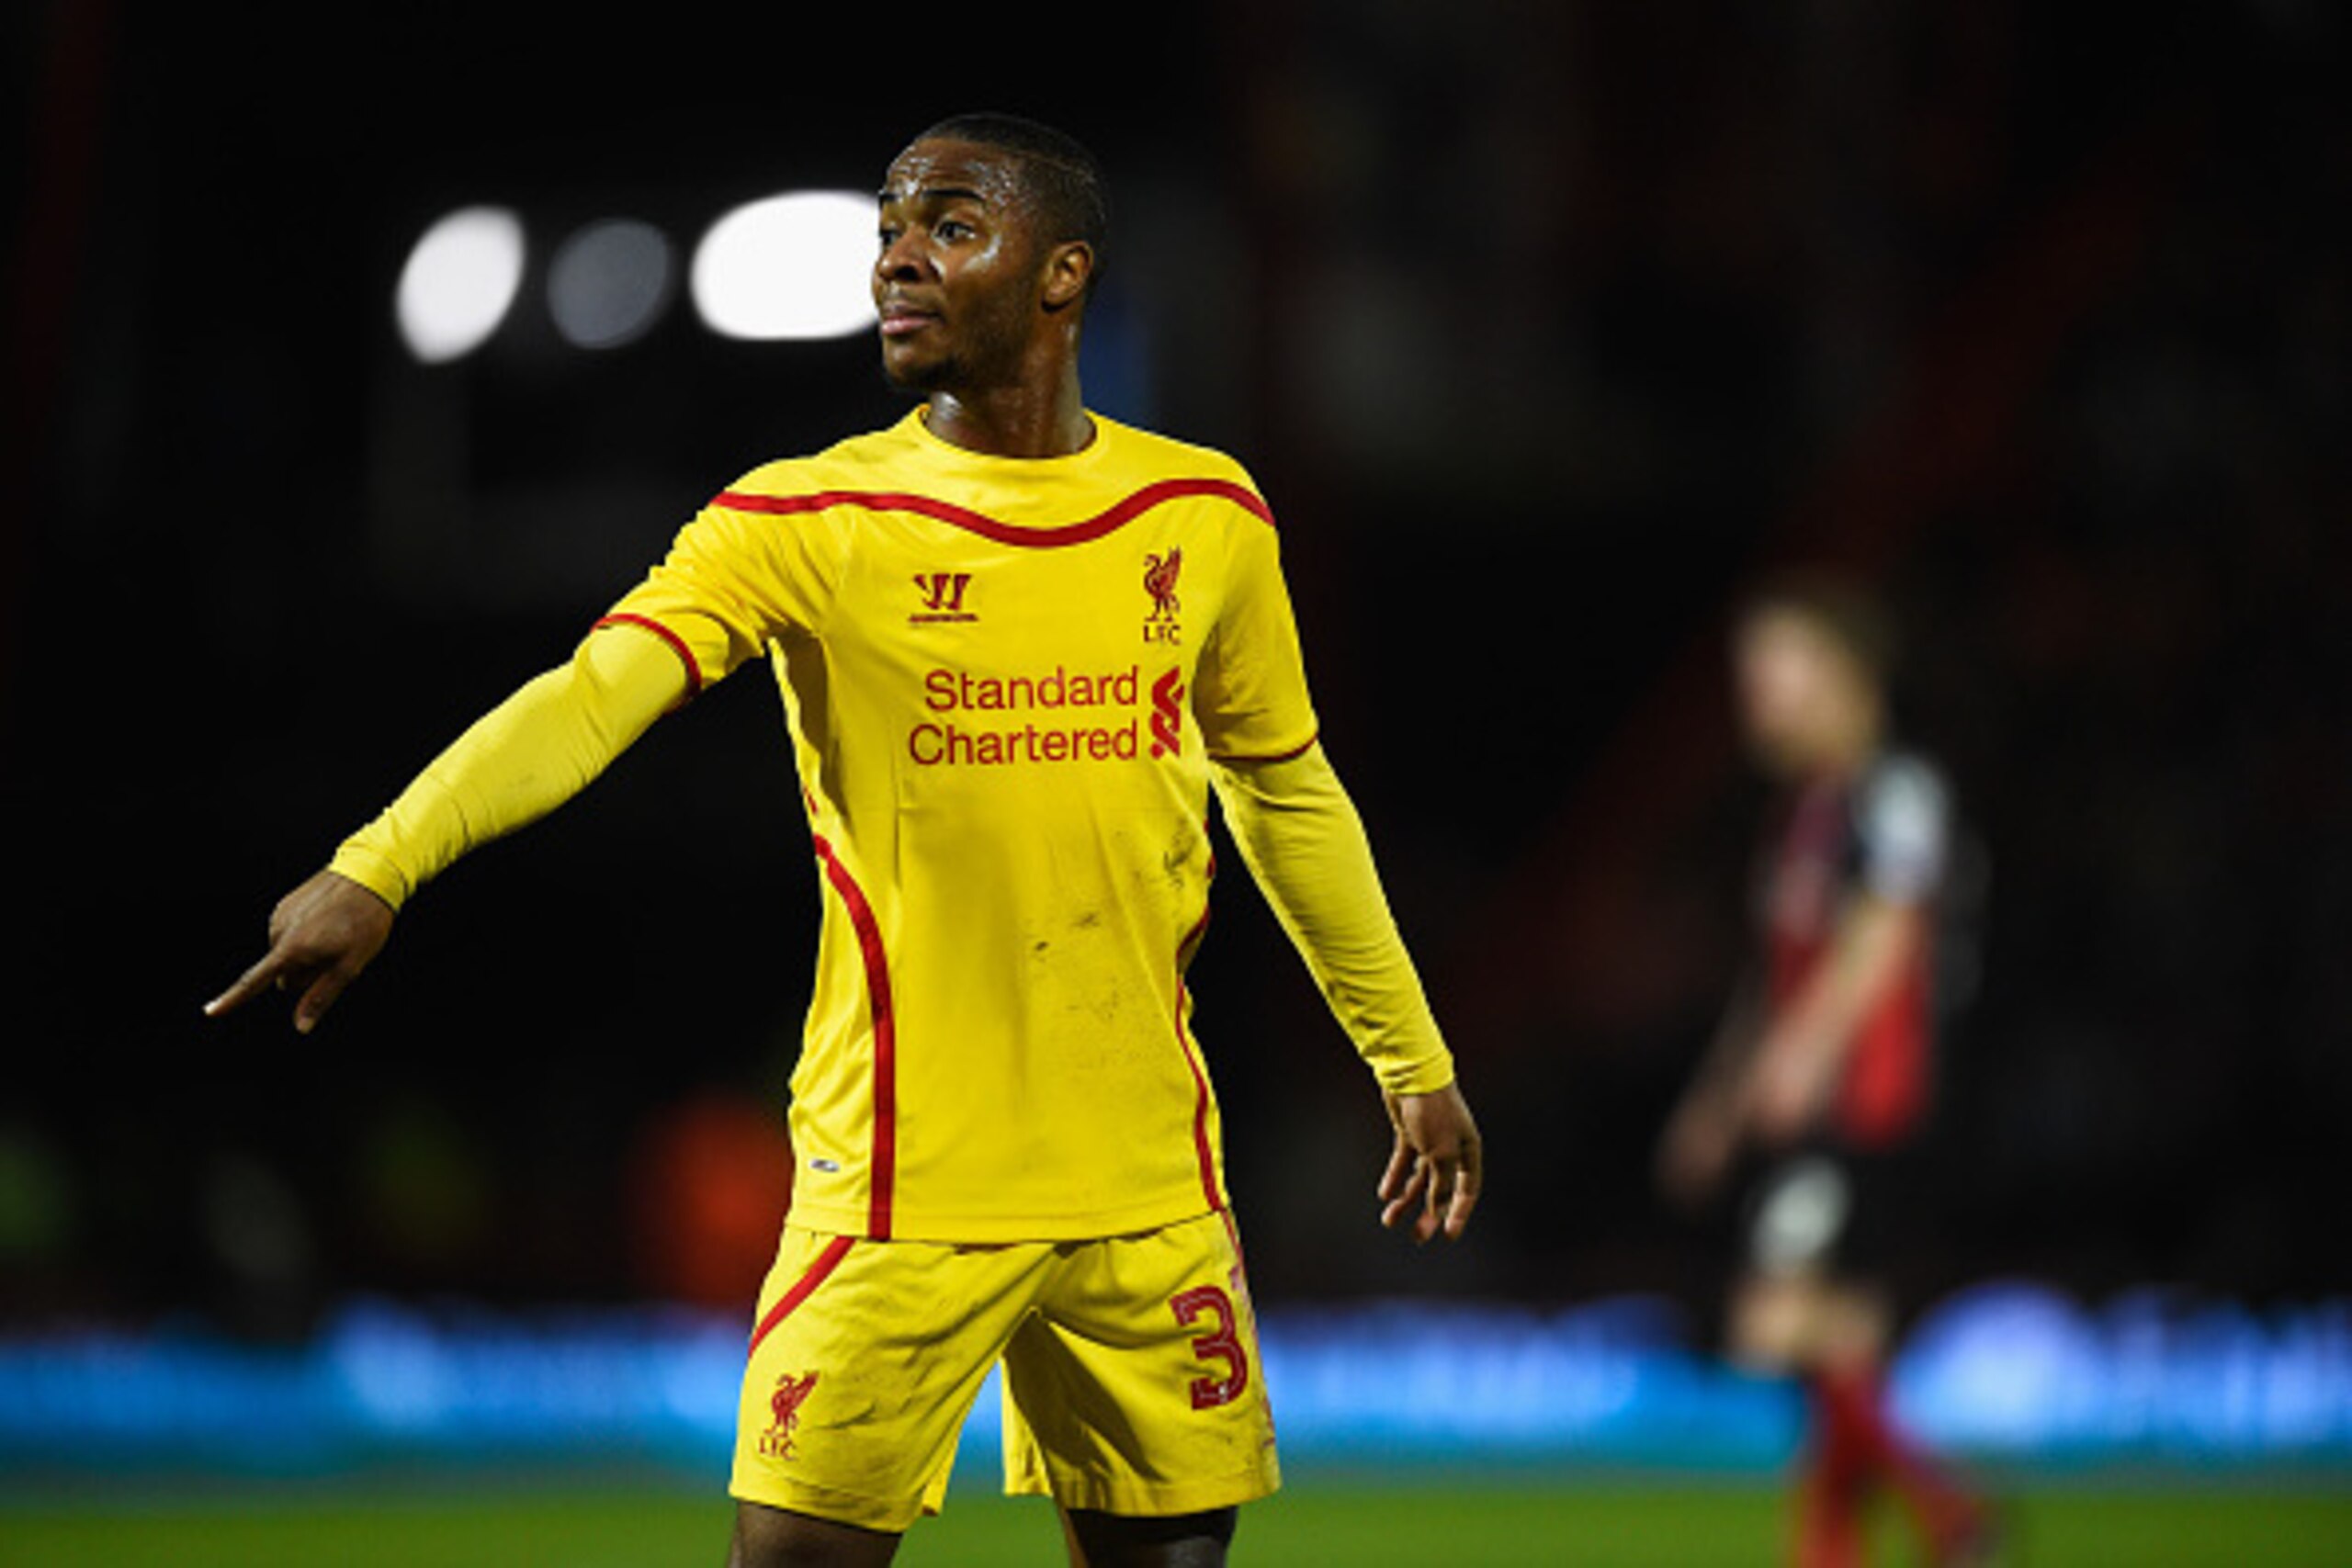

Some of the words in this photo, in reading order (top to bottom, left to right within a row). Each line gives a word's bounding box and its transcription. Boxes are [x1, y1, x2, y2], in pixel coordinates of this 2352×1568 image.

[1143, 625, 1182, 645] LFC
[924, 664, 1138, 712] Standard
[908, 718, 1137, 765] Chartered
[1170, 1266, 1251, 1411] 3
